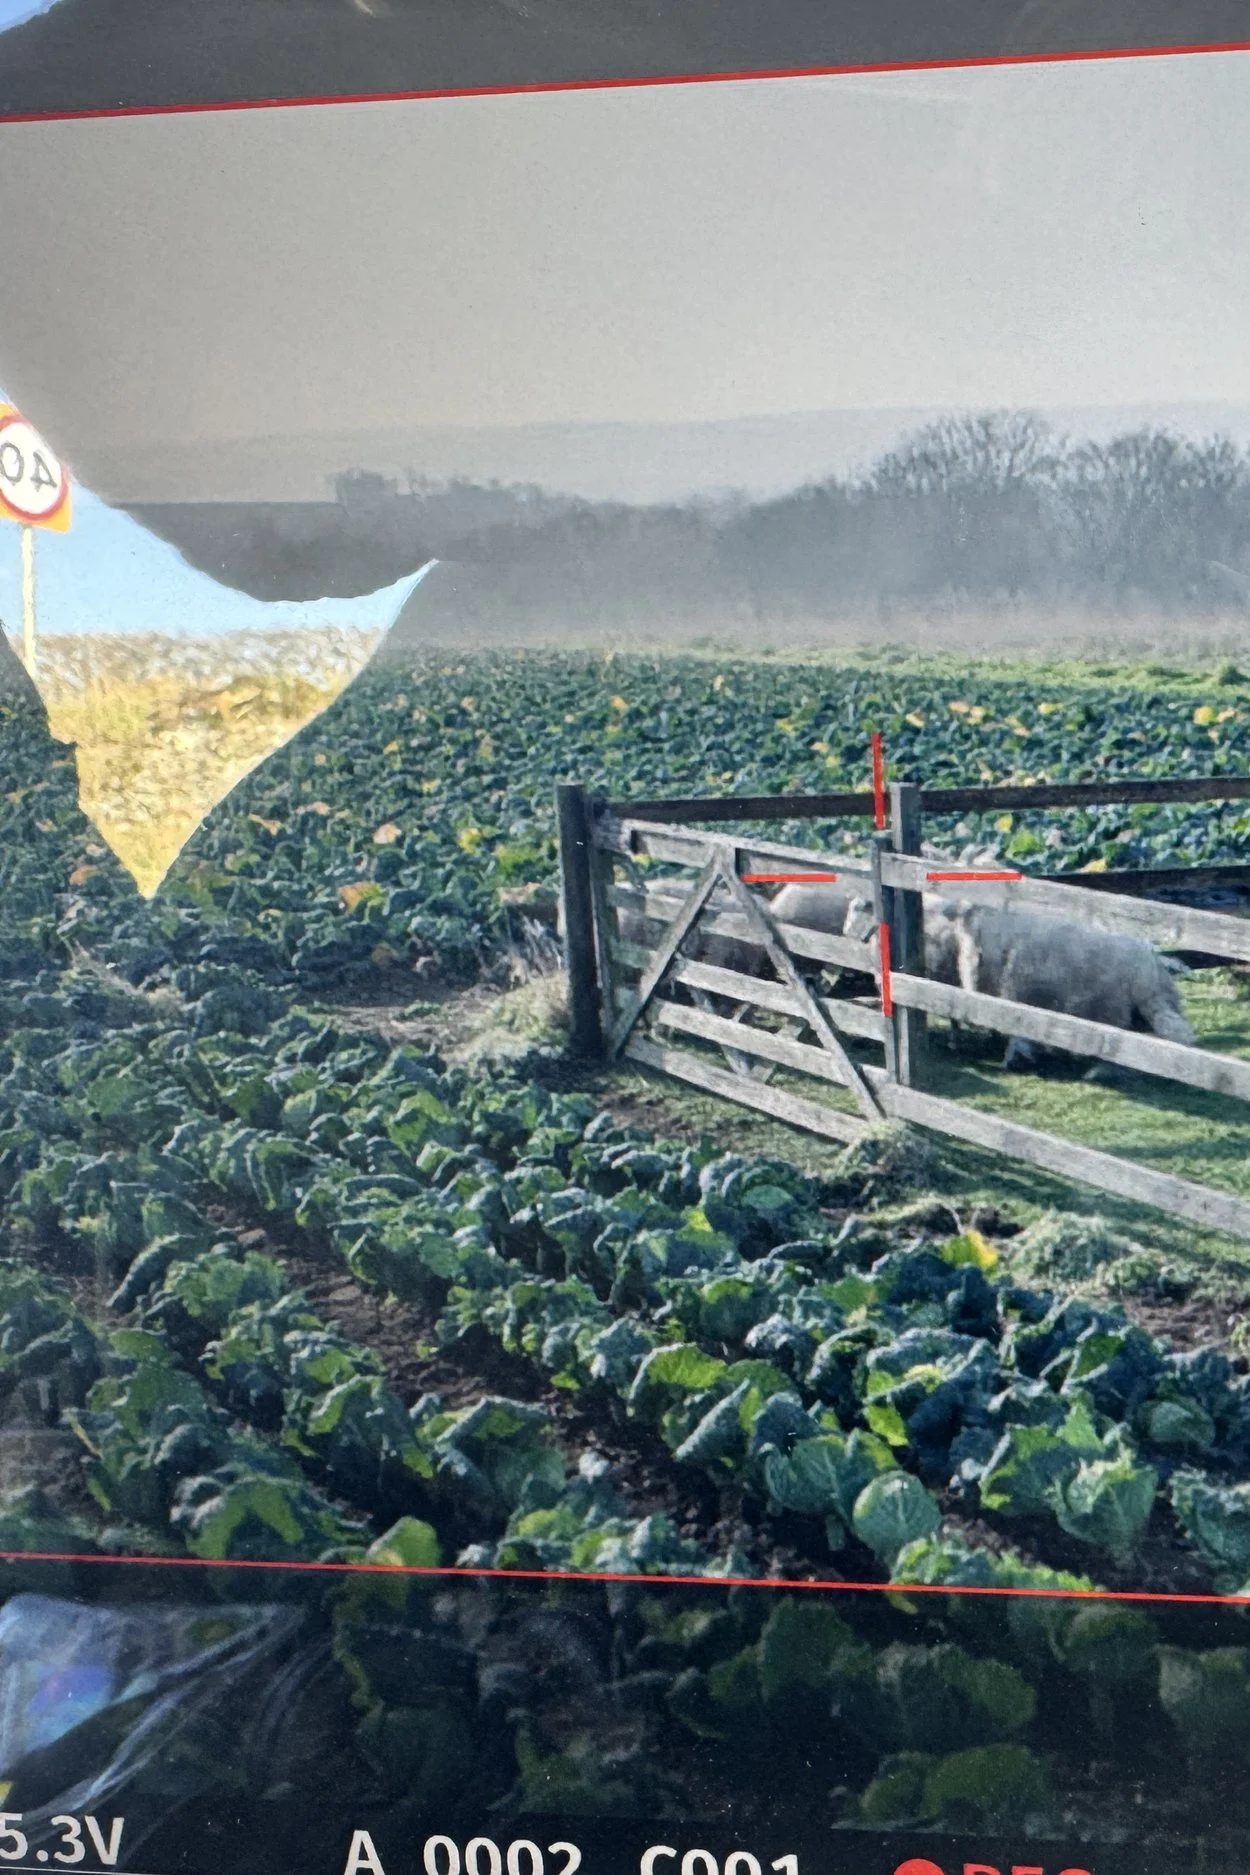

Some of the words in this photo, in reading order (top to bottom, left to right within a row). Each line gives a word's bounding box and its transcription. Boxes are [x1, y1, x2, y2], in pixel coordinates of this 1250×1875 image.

[0, 1811, 125, 1865] 5.3V
[343, 1829, 386, 1875] A
[423, 1834, 583, 1875] 0002
